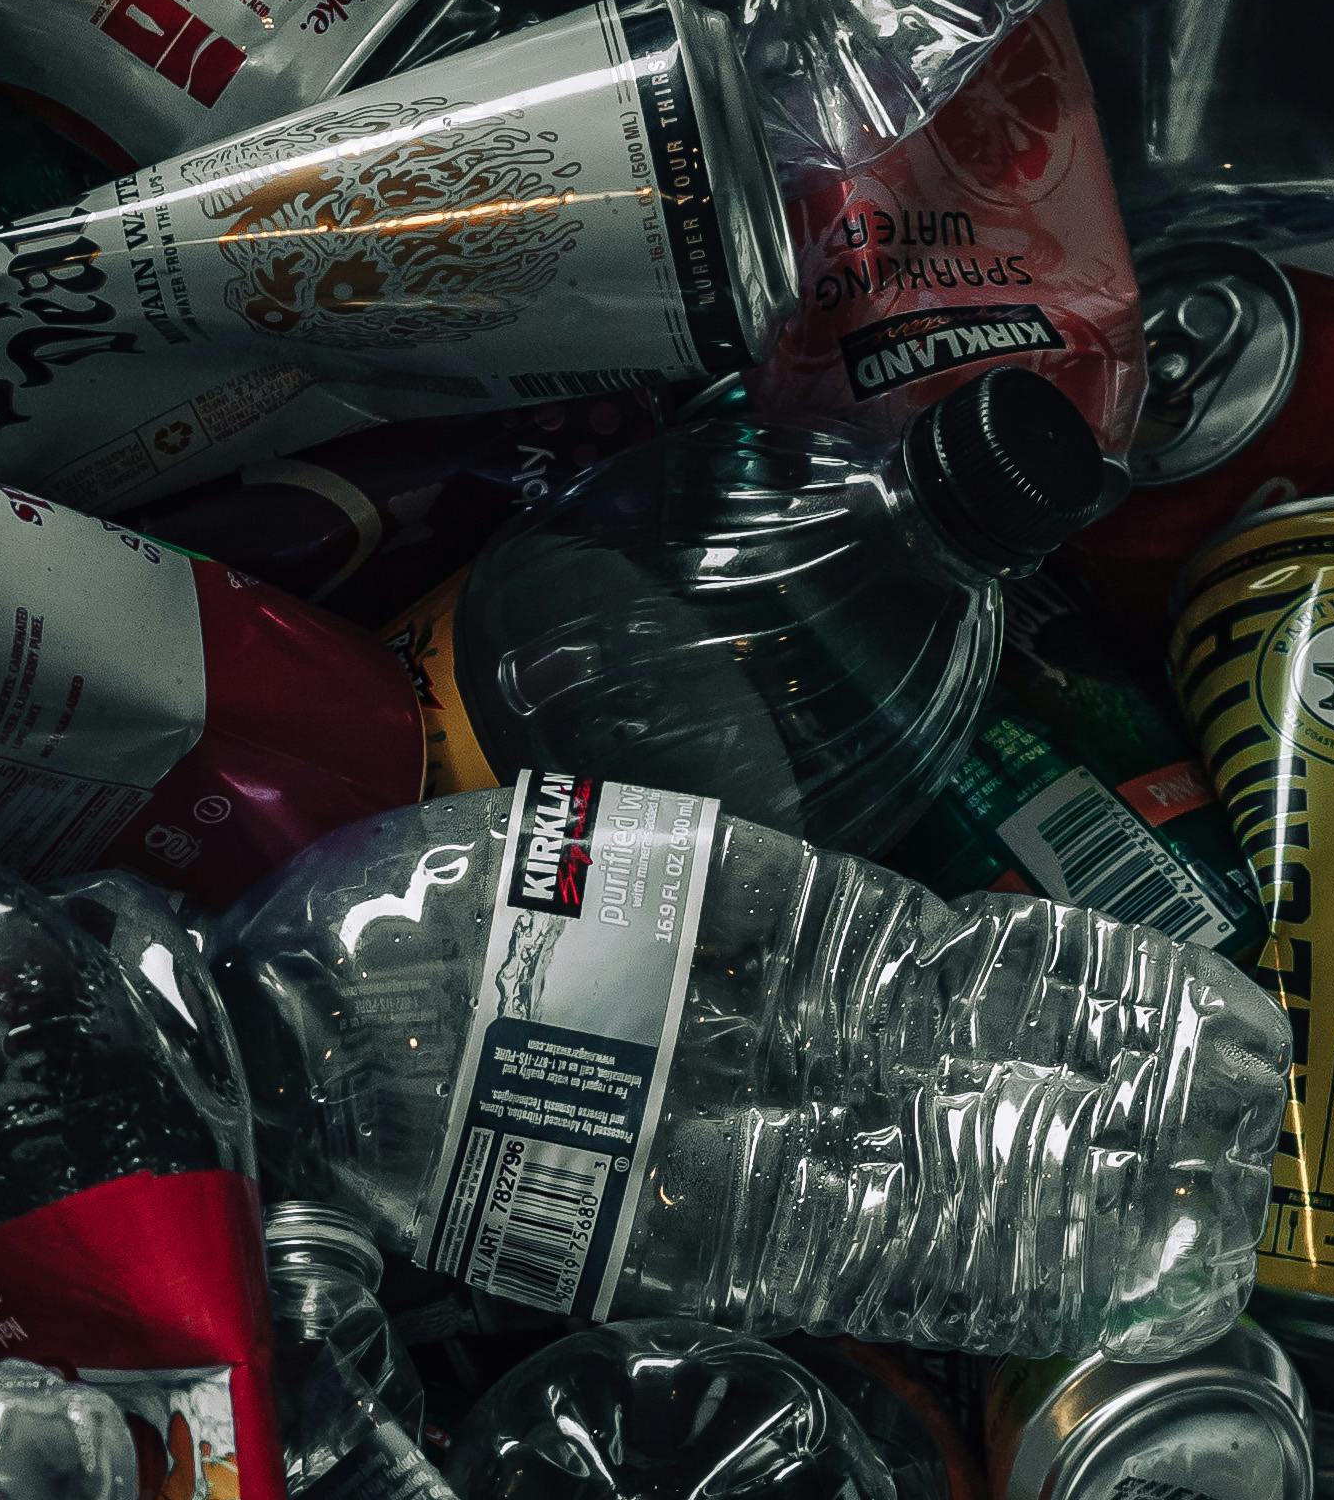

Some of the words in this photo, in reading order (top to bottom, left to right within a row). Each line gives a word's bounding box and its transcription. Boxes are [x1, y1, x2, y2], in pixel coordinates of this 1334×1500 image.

[620, 110, 644, 143] ML)
[628, 142, 652, 180] (500
[667, 139, 694, 206] YOUR
[846, 210, 976, 251] WATER
[683, 216, 716, 306] MURDER
[815, 253, 1033, 312] SPARKLING
[856, 315, 1055, 390] KIRKLAND
[523, 771, 578, 902] KIRKLAN
[674, 815, 693, 853] (500
[601, 810, 635, 928] purified
[663, 880, 681, 904] FL
[669, 855, 687, 880] OZ
[655, 907, 677, 944] 16.9
[491, 1141, 526, 1217] 782796
[569, 1195, 598, 1256] 75680
